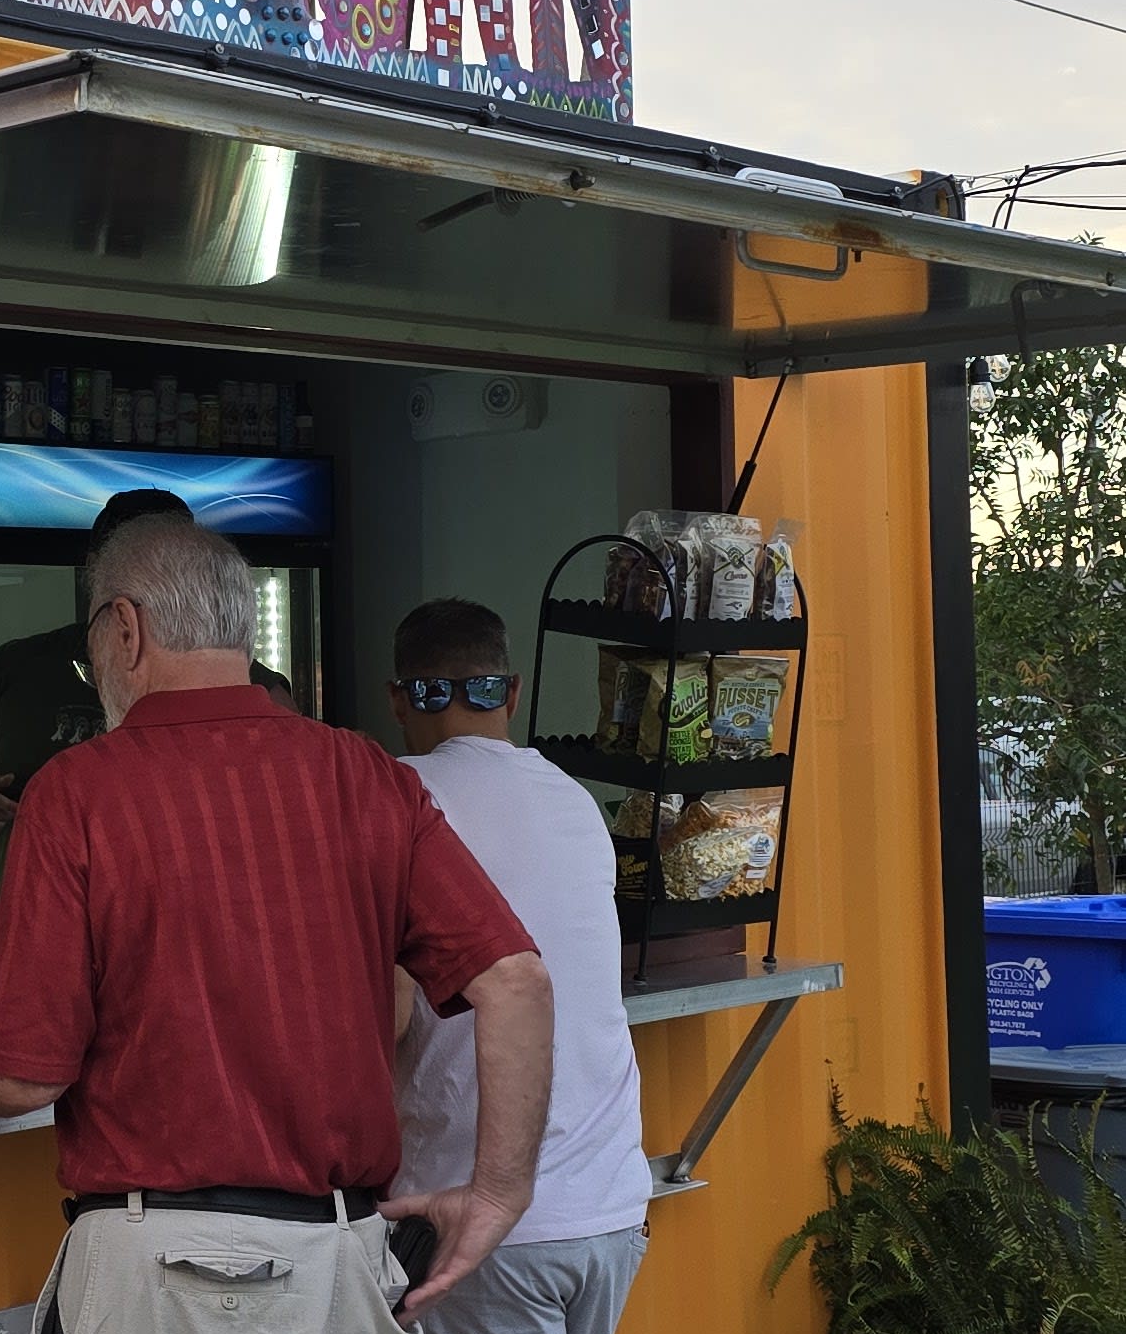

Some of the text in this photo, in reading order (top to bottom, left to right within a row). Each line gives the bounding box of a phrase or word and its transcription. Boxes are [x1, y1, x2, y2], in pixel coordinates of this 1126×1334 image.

[716, 687, 779, 718] RUSSET
[986, 968, 1035, 982] GTON
[987, 998, 1043, 1011] YCLING ONLY
